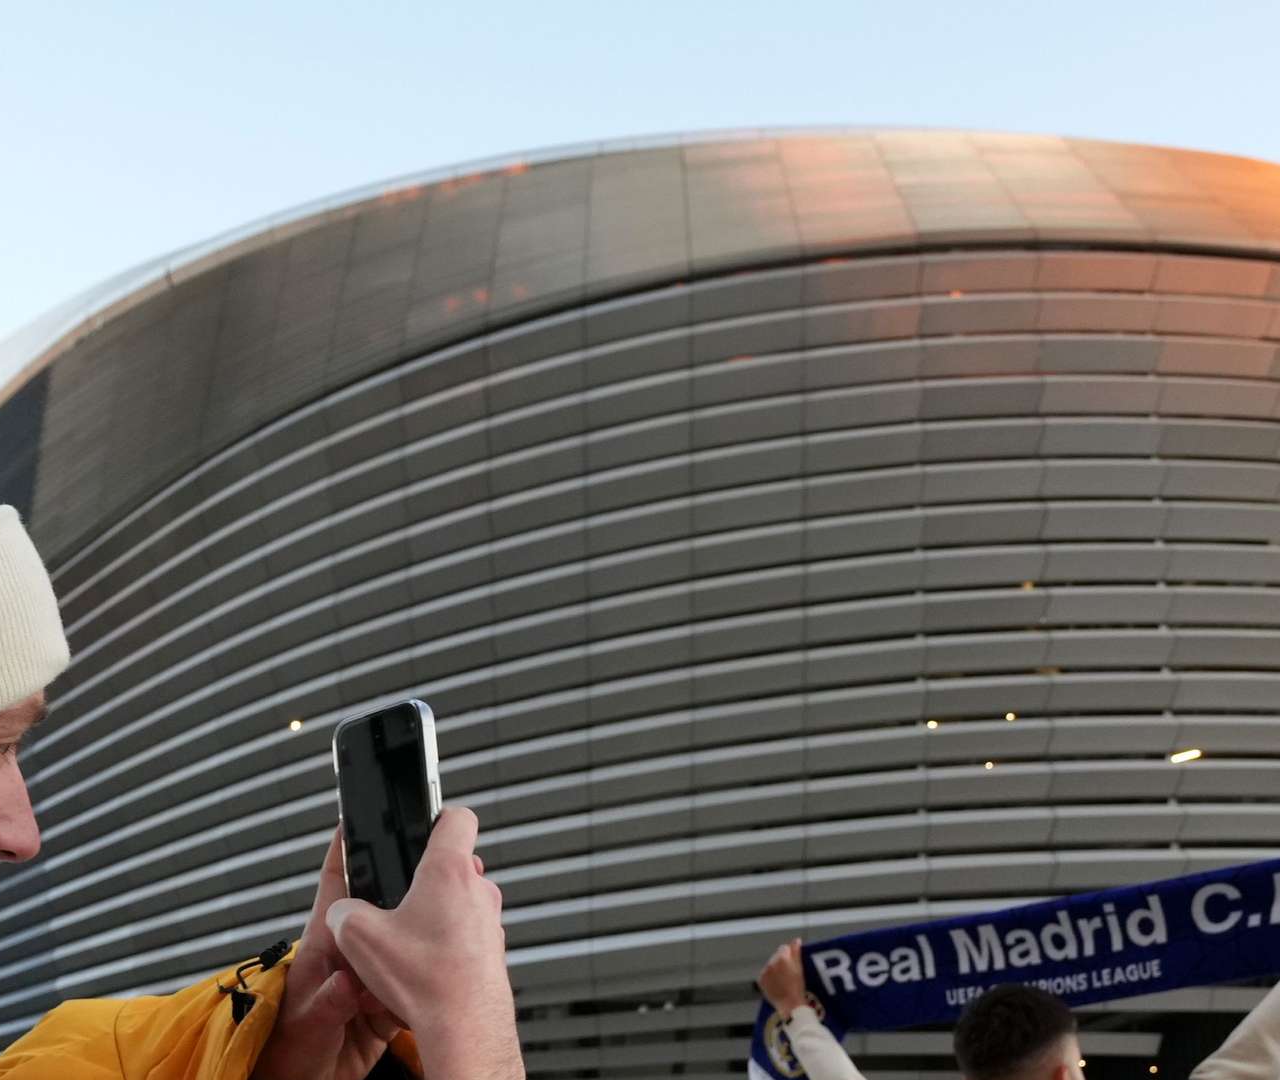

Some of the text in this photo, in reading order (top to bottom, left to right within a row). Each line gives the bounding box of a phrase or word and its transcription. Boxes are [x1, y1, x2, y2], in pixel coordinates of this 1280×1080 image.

[811, 934, 936, 996] Real
[949, 894, 1168, 976] Madrid
[1092, 959, 1162, 989] LEAGUE
